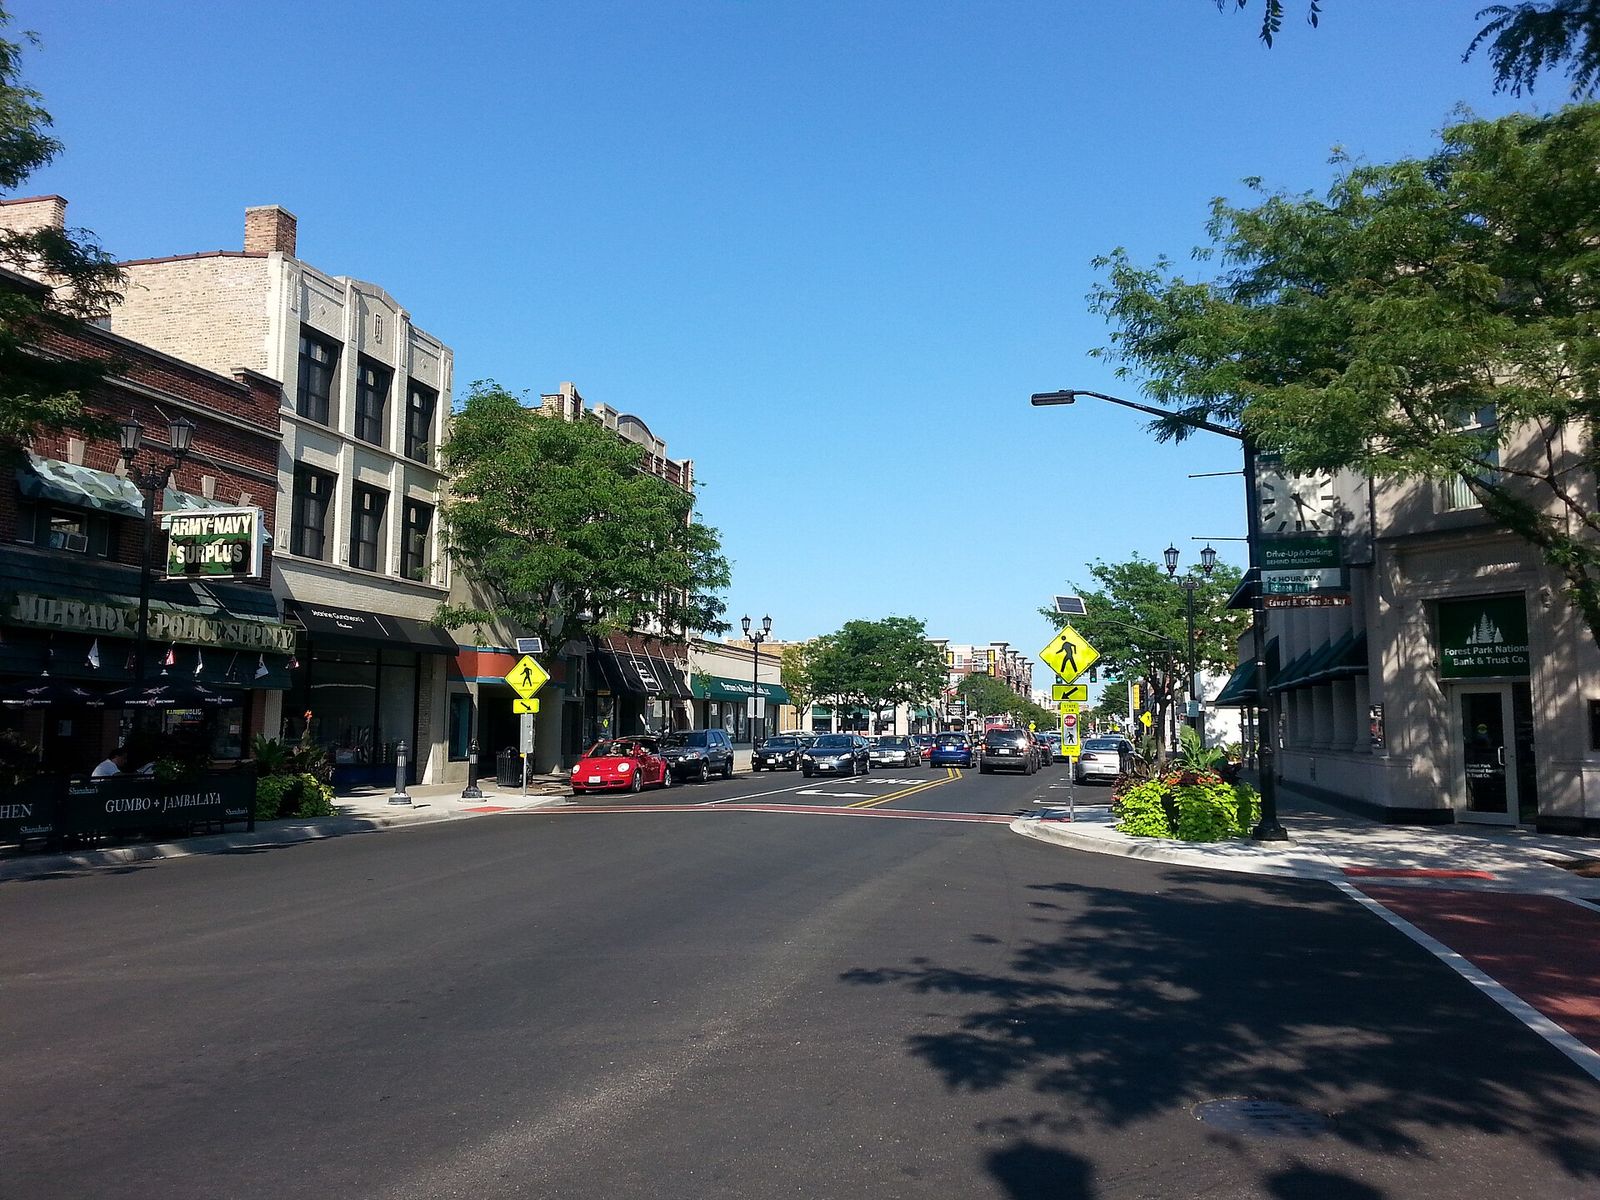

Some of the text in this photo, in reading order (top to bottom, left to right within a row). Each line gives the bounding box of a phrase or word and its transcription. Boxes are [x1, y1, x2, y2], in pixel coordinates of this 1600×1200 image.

[171, 515, 251, 536] ARMY-NAVY
[176, 544, 243, 564] SURPLUS
[1266, 550, 1298, 558] Drive-Up
[1305, 549, 1333, 557] Parking
[1269, 599, 1291, 607] Edward
[14, 594, 129, 632] MILITARY
[155, 613, 222, 642] POLICE
[224, 622, 293, 649] SUPPLY
[1444, 648, 1471, 656] Forest
[1473, 646, 1493, 654] Park
[1453, 655, 1527, 666] Bank & Trust Co.
[105, 797, 151, 813] GUMBO
[162, 792, 221, 813] JAMBALAYA
